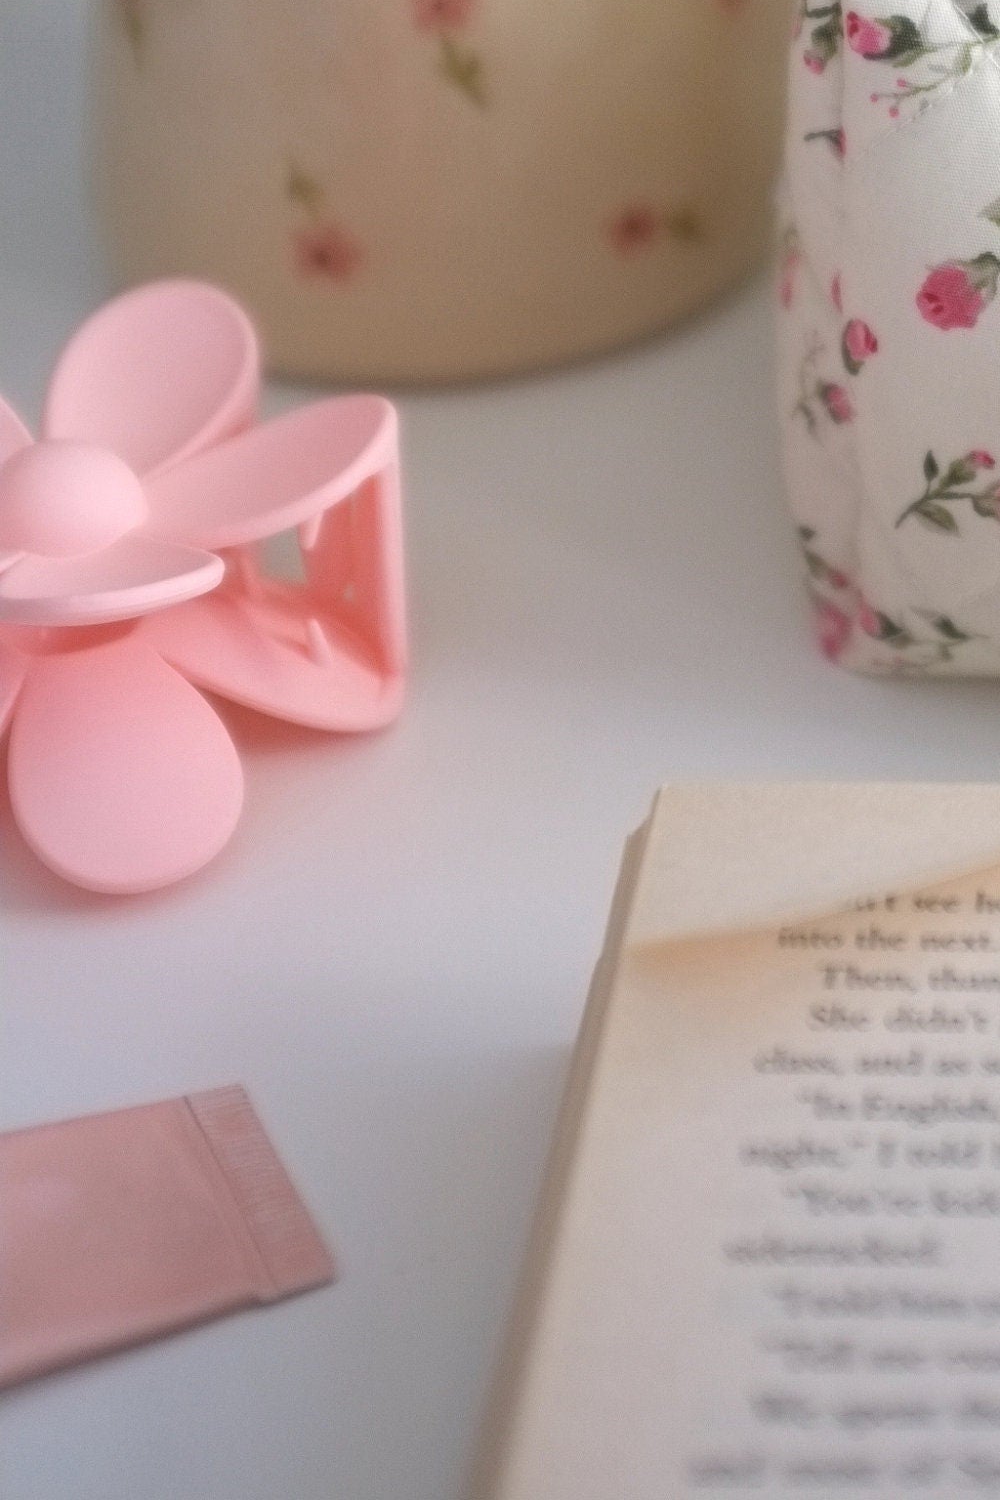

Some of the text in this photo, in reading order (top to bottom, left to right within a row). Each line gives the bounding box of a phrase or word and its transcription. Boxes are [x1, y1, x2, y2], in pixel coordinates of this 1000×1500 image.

[913, 896, 960, 912] see
[779, 927, 998, 950] into the next.
